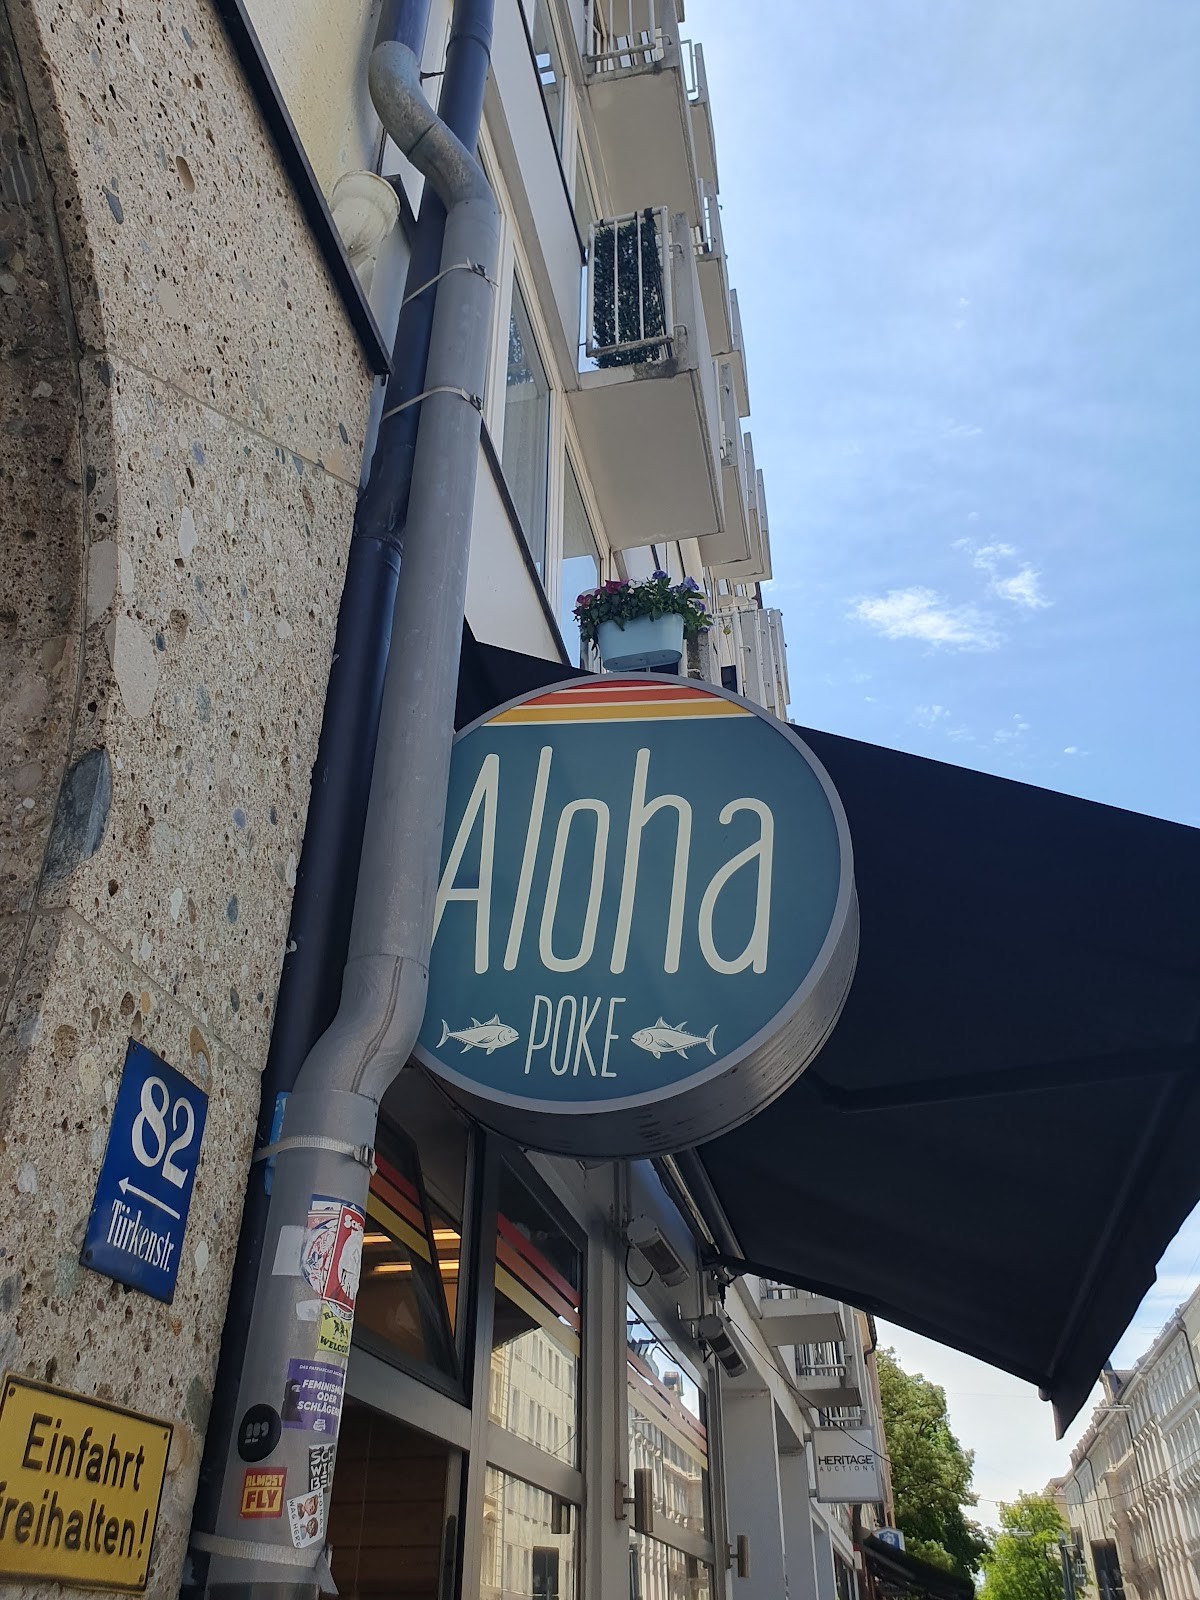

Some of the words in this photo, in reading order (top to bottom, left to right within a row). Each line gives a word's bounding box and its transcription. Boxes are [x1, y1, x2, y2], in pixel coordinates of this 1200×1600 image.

[432, 746, 774, 974] Aloha
[524, 995, 627, 1077] POKE
[131, 1076, 195, 1189] 82
[106, 1199, 174, 1272] Türkenstr.
[317, 1391, 337, 1404] ODER
[22, 1412, 145, 1491] Einfahrt
[246, 1474, 284, 1487] ALMOST
[818, 1455, 873, 1465] HERITAGE
[246, 1490, 278, 1508] FLY
